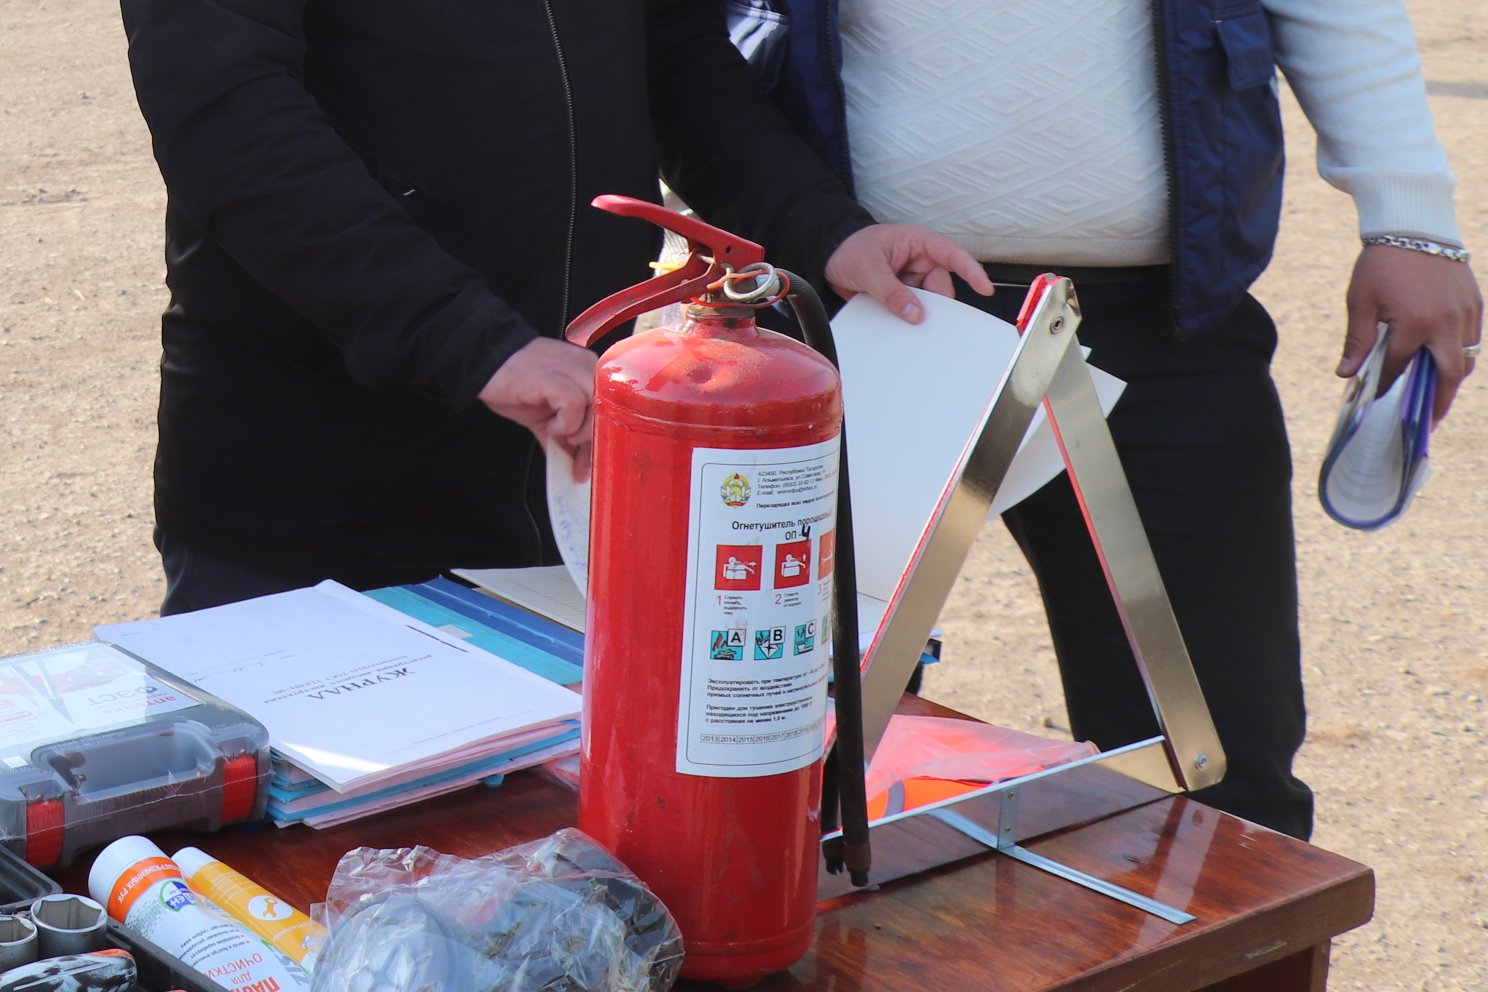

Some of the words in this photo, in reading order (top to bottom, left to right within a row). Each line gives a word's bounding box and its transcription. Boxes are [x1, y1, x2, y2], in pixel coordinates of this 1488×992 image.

[732, 519, 795, 532] Огнетушитель
[785, 530, 796, 540] ОП
[717, 595, 722, 605] 1
[775, 594, 782, 604] 2
[774, 629, 782, 641] B
[808, 622, 814, 635] C
[731, 632, 741, 643] A
[305, 667, 416, 699] ЖУРНАЛ
[86, 686, 158, 706] ФЭСТ
[102, 696, 177, 714] аптечка
[117, 886, 128, 904] РУК
[204, 953, 263, 979] ОЧИСТКИ
[230, 970, 252, 984] ДЛЯ
